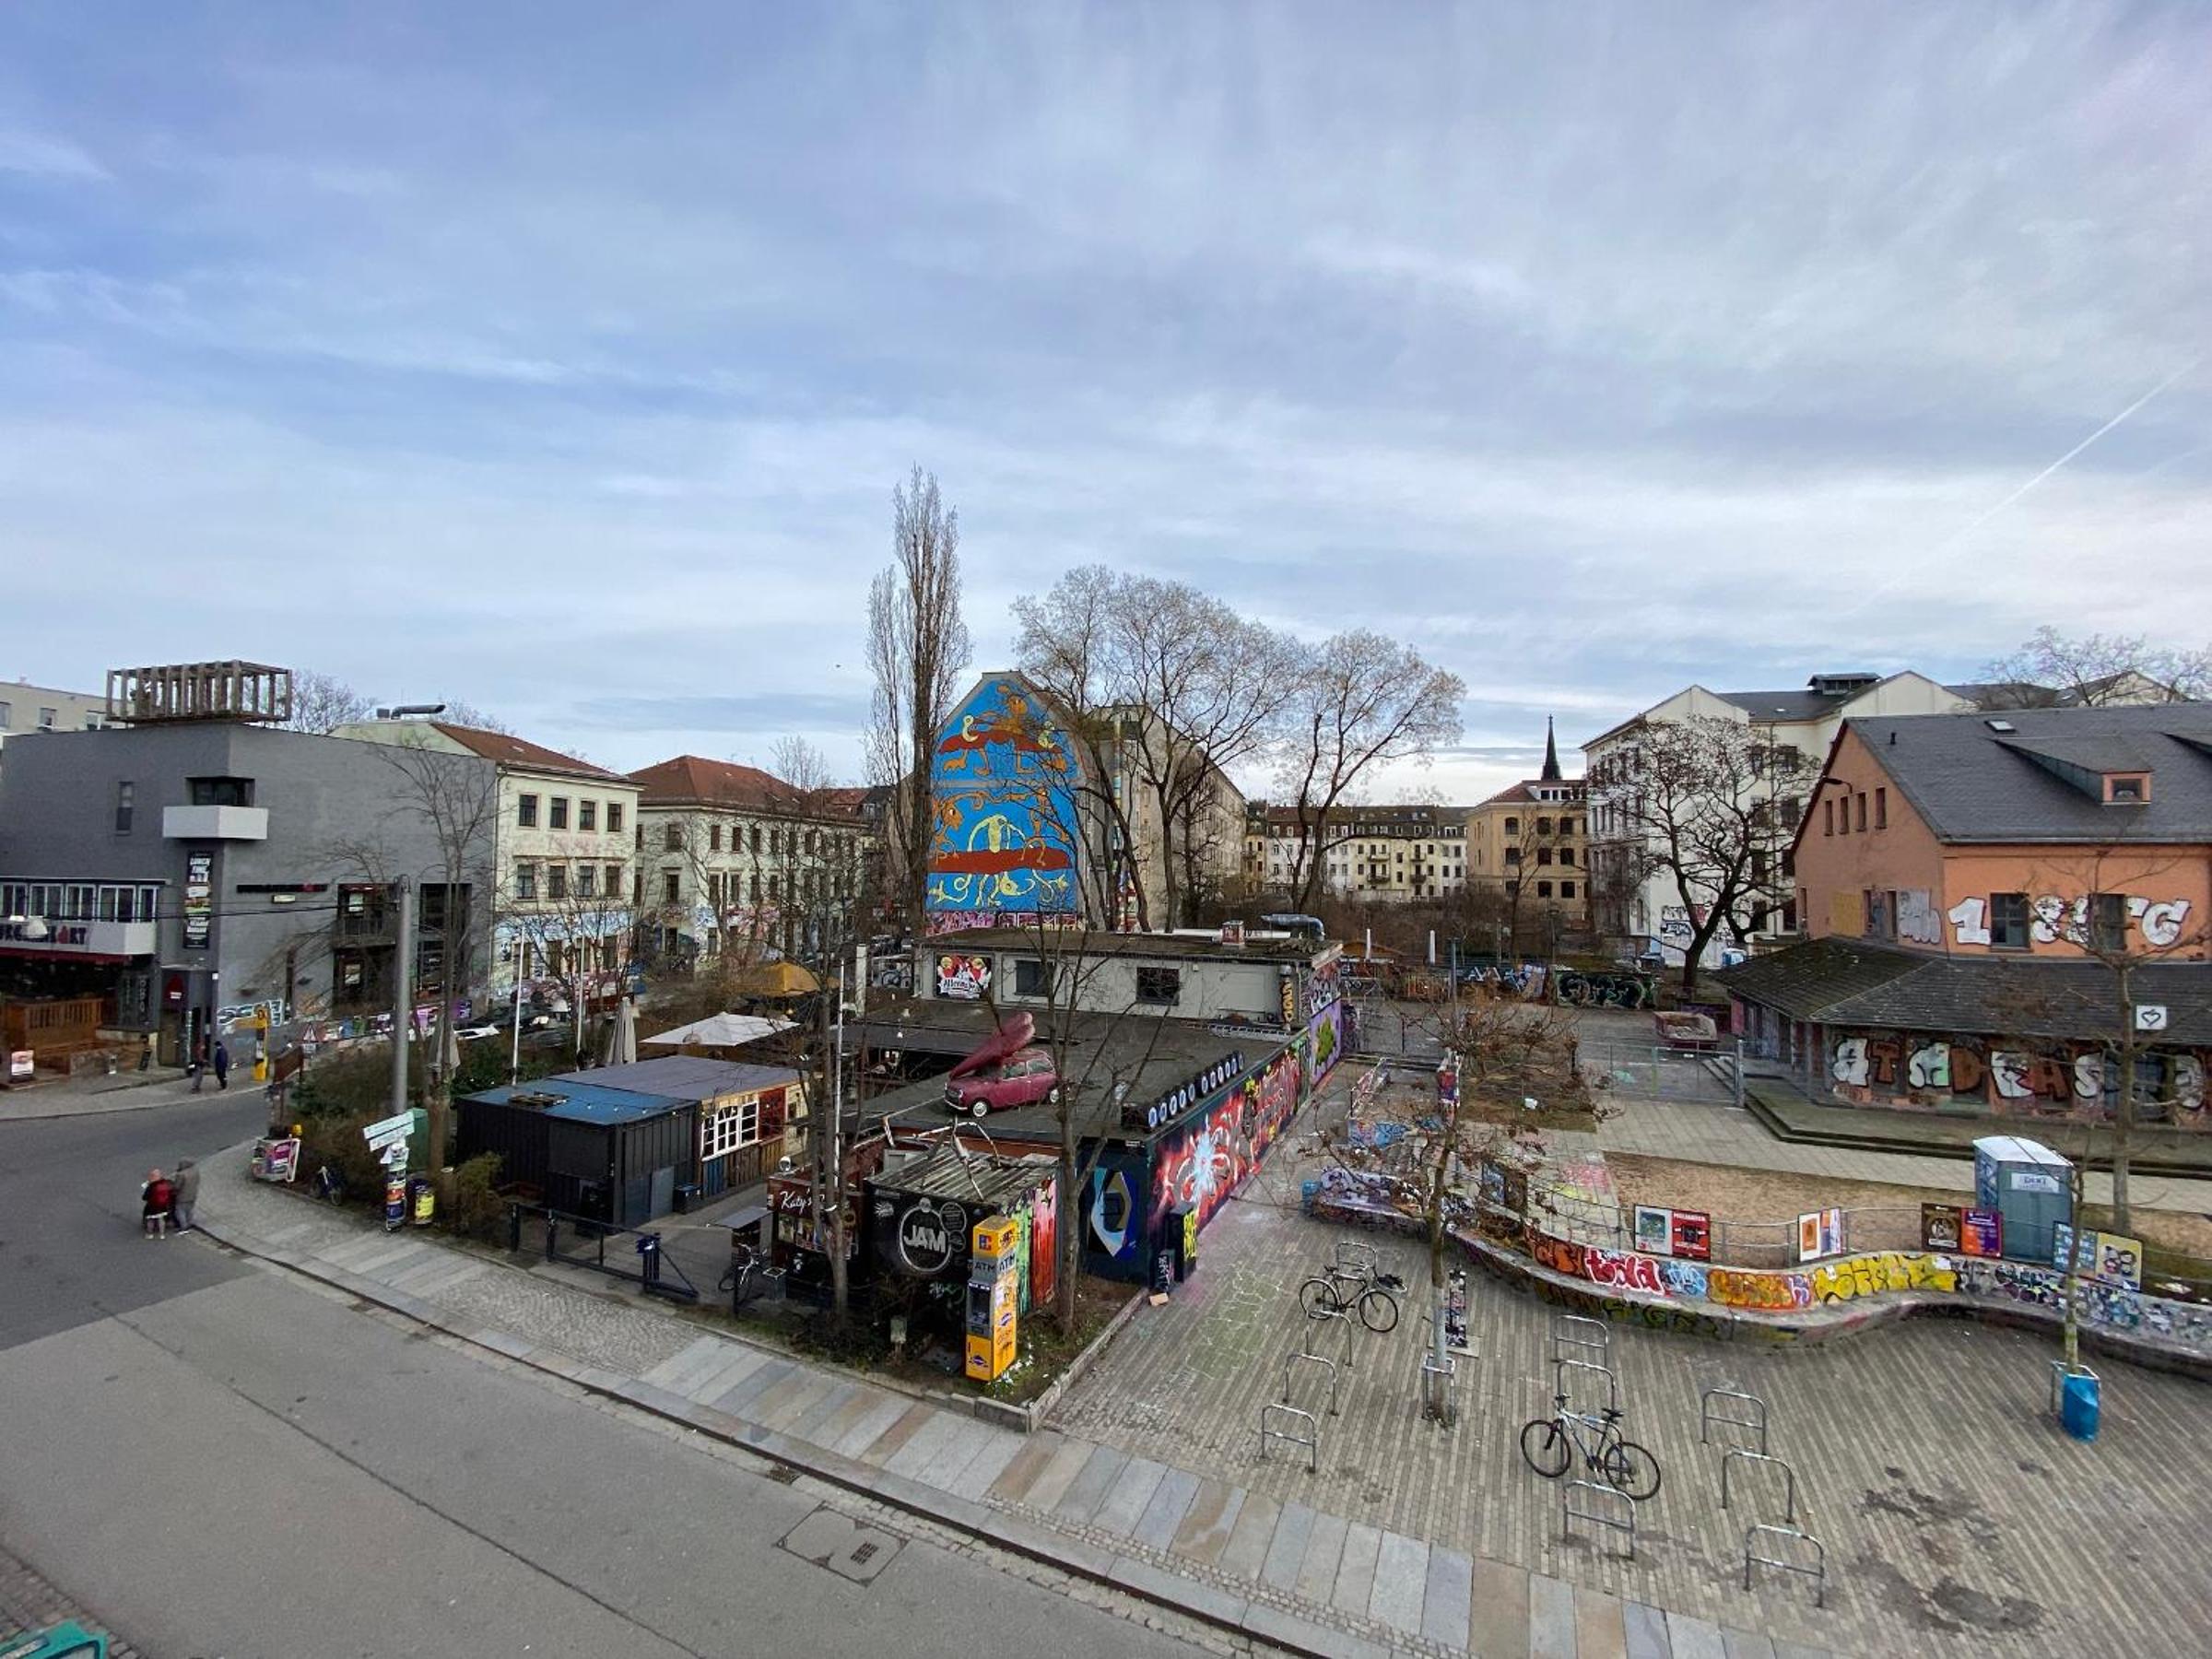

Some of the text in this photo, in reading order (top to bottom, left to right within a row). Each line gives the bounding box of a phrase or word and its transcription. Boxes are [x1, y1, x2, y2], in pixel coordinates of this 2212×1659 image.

[902, 1224, 947, 1254] JAM
[974, 1261, 995, 1272] ATM
[999, 1253, 1016, 1272] ATM
